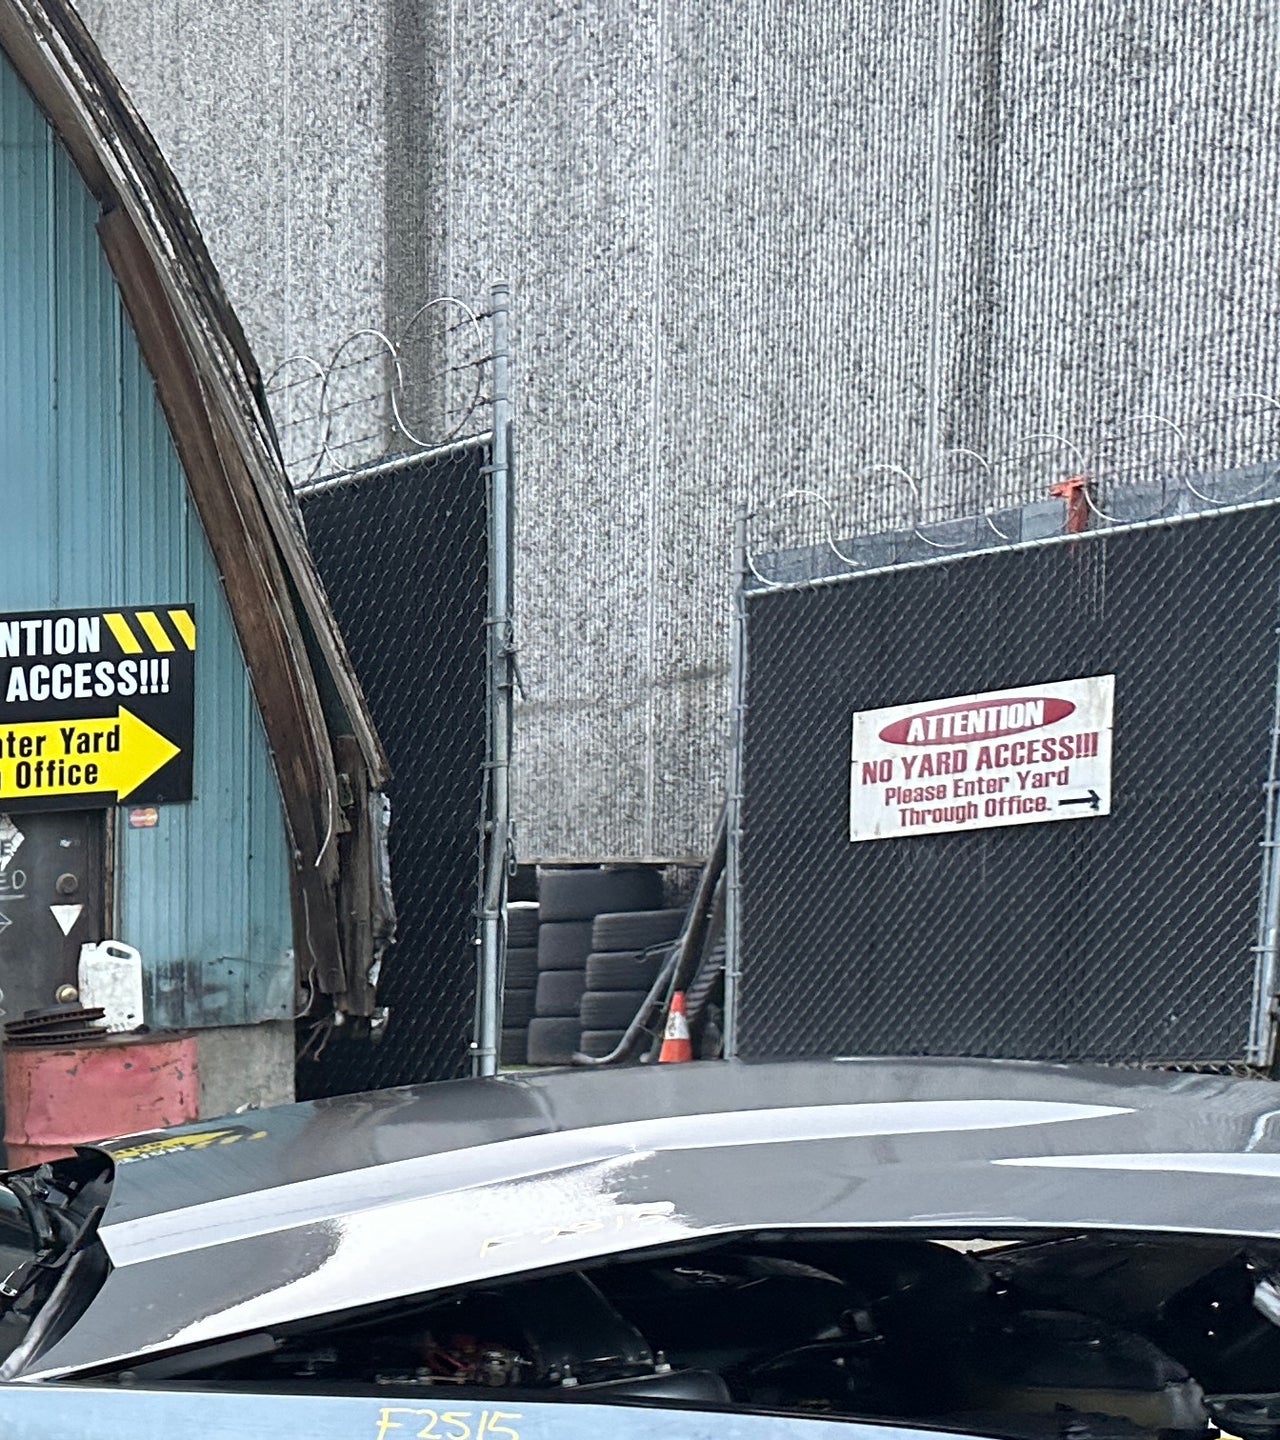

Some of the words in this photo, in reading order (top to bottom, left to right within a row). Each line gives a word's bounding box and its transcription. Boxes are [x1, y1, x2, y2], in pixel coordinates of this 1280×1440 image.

[5, 658, 171, 702] ACCESS!!!
[60, 725, 121, 755] Yard
[906, 700, 1045, 743] ATTENTION
[15, 761, 99, 790] Office
[862, 759, 893, 785] NO
[901, 749, 968, 779] YARD
[975, 731, 1099, 771] ACCESS!!!
[885, 783, 947, 806] Please
[953, 775, 1010, 798] Enter
[1016, 766, 1070, 790] Yard
[899, 801, 978, 827] Through
